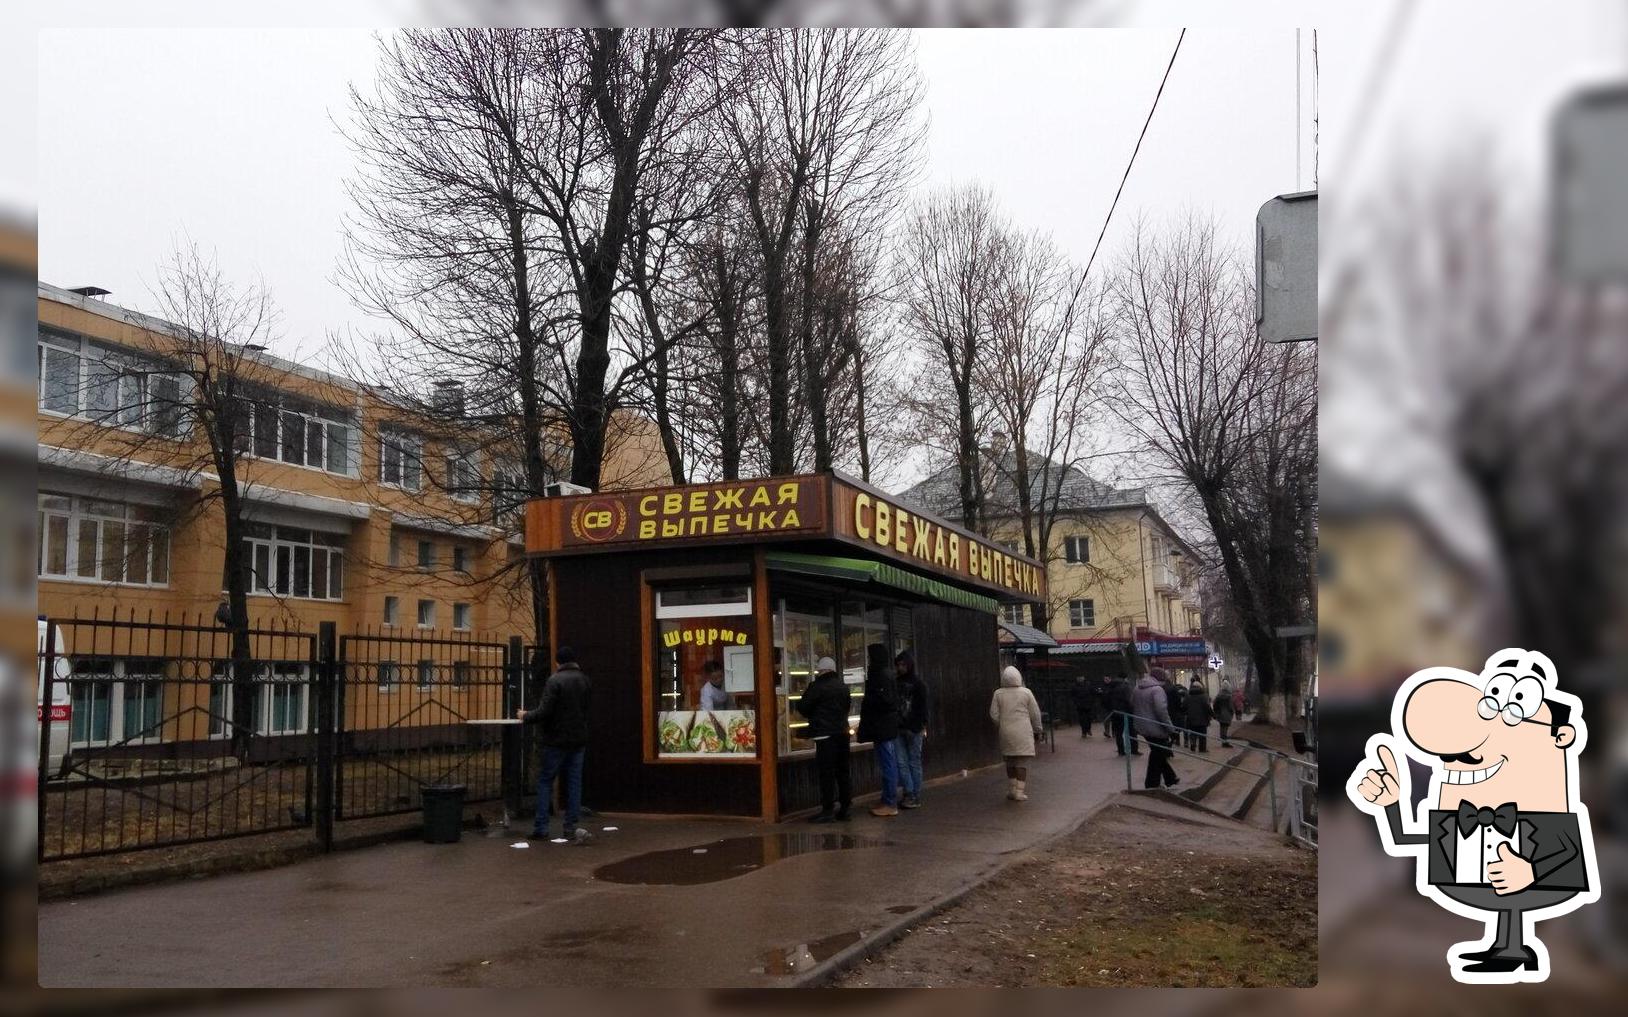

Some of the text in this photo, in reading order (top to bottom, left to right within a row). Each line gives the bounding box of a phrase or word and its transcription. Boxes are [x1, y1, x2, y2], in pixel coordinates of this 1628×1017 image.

[639, 483, 800, 517] СВЕЖАЯ
[583, 511, 613, 529] СВ
[639, 509, 801, 539] ВЫПЕЧКА
[855, 493, 1040, 597] СВЕЖАЯ ВЫПЕЧКА
[663, 628, 748, 648] Шаурма
